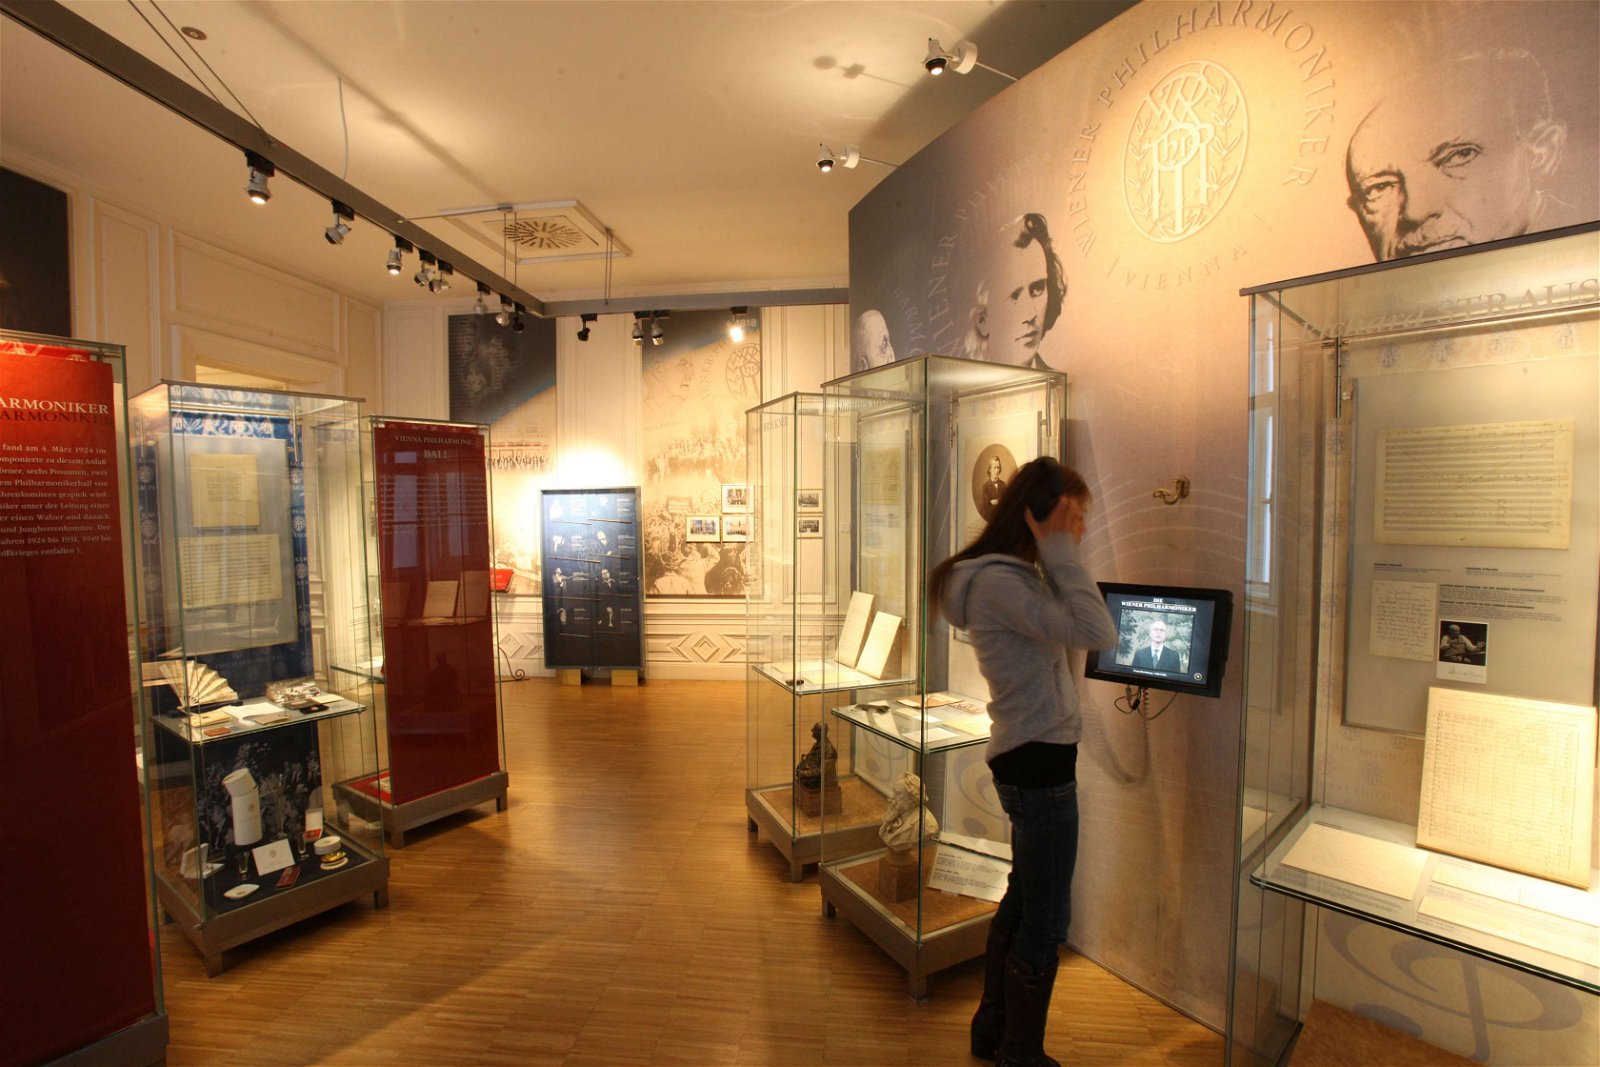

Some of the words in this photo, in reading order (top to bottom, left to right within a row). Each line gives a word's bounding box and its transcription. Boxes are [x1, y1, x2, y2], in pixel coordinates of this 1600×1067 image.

[1068, 122, 1101, 257] WIENER
[1097, 0, 1335, 187] PHILHARMONIKER
[395, 434, 422, 443] VIENNA
[424, 436, 474, 446] PHILHARMONIC
[2, 443, 23, 452] fand
[52, 445, 72, 454] März
[75, 446, 93, 455] 1924
[424, 449, 450, 460] BALL
[45, 502, 58, 510] der
[36, 513, 64, 521] Walzer
[66, 513, 81, 521] und
[27, 537, 46, 545] 1924
[1143, 602, 1197, 612] PHILHARMONIKER
